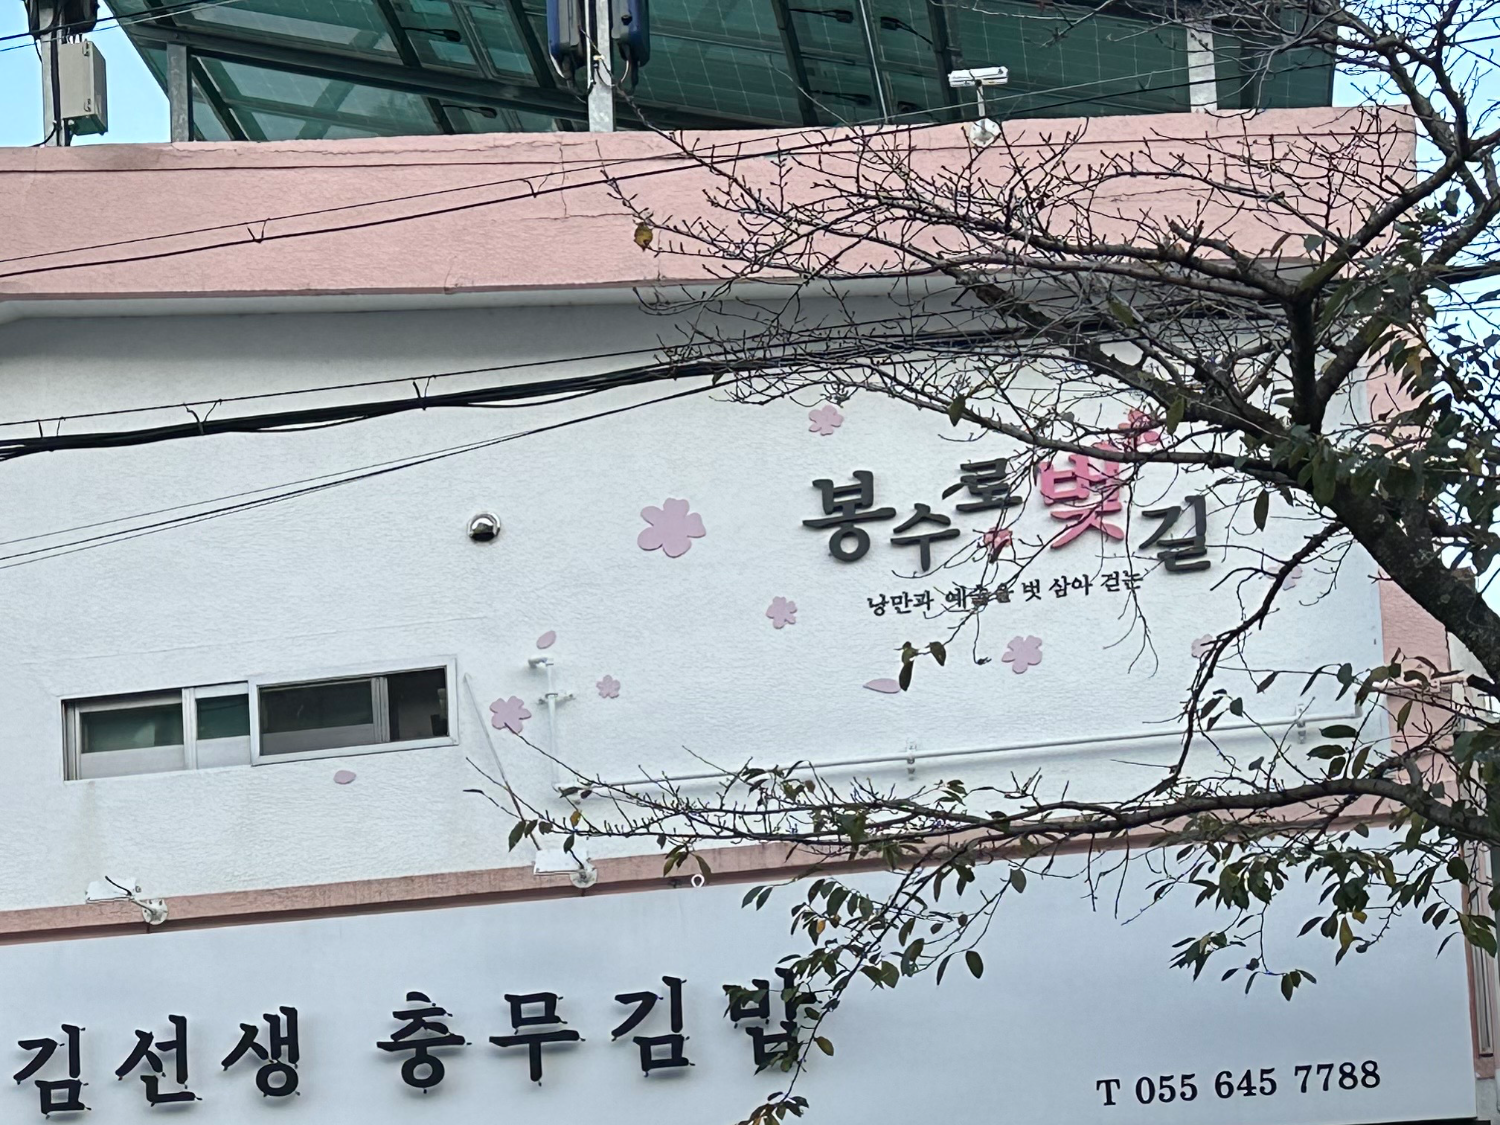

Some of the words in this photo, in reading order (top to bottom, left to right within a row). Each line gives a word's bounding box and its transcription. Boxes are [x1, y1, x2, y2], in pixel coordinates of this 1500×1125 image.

[867, 589, 935, 616] 낭만과
[1049, 574, 1093, 599] 삼아
[13, 1006, 302, 1118] 김선생
[376, 967, 818, 1093] 충무김밥
[1096, 1079, 1121, 1106] T
[1135, 1073, 1198, 1105] 055
[1214, 1067, 1277, 1099] 645
[1293, 1060, 1381, 1094] 7788
